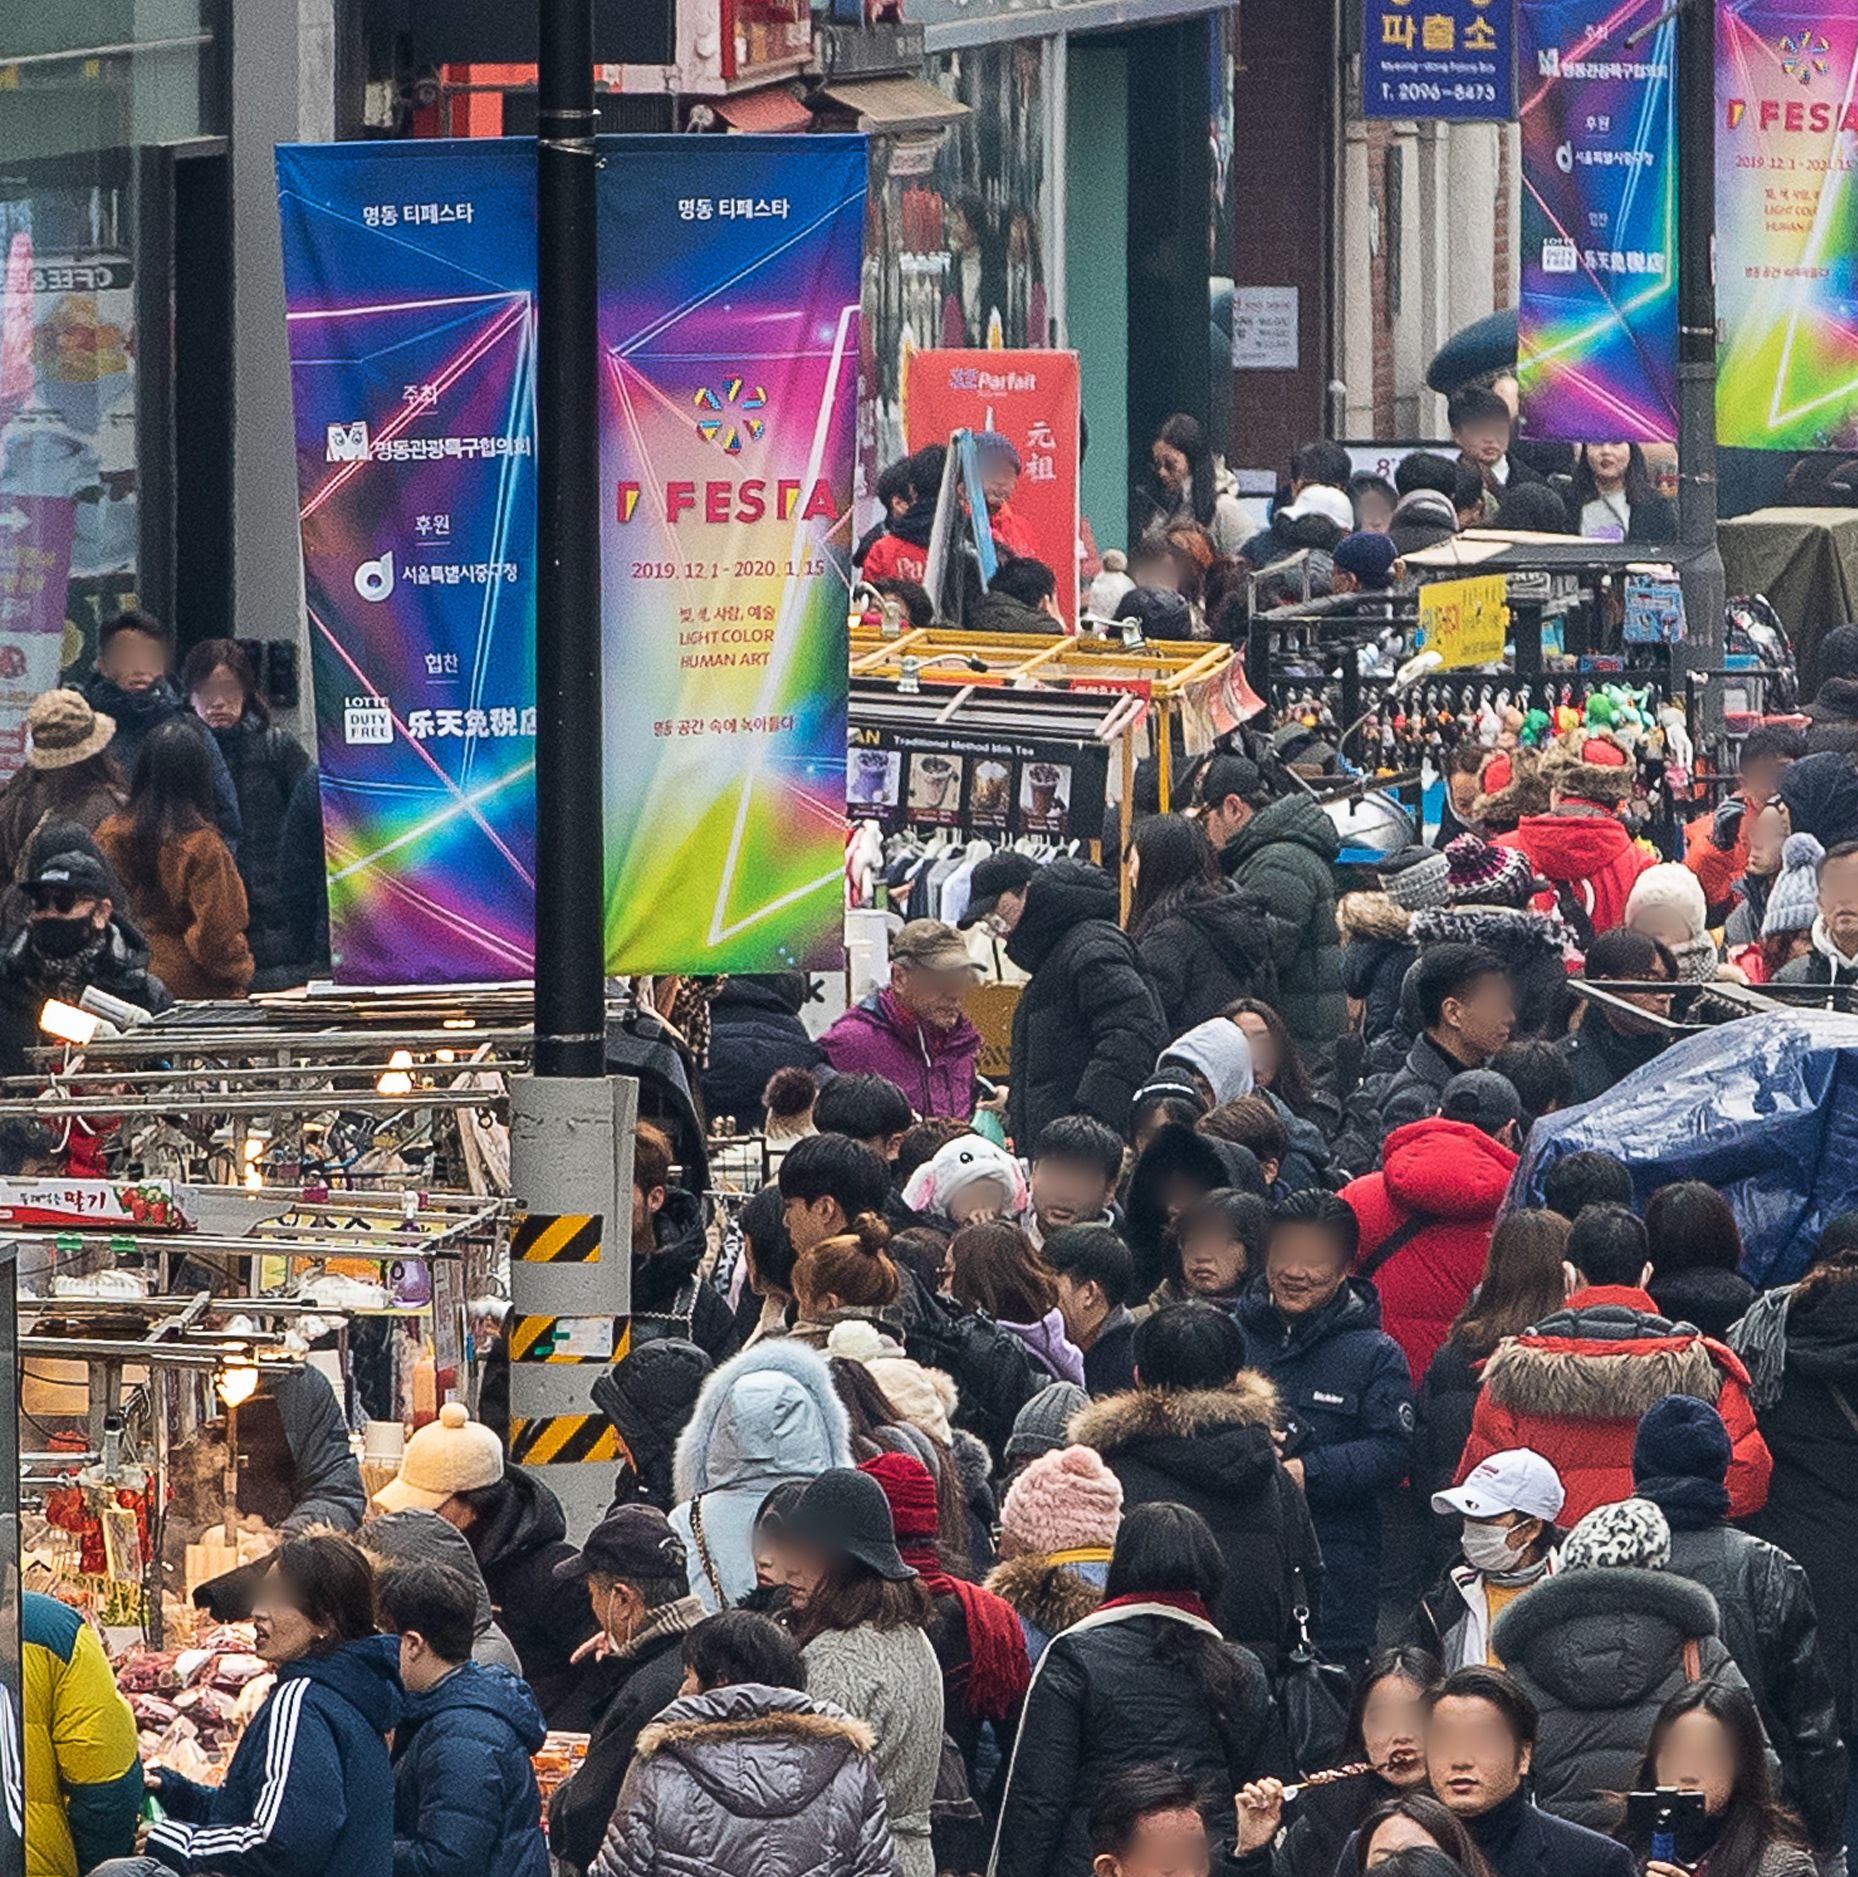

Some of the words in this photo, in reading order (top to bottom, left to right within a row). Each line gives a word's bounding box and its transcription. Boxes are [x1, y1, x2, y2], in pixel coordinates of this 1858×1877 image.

[1381, 13, 1498, 50] 파출소
[363, 204, 398, 226] 명동
[403, 202, 475, 225] 티페스타
[677, 198, 713, 221] 명동
[718, 198, 790, 220] 티페스타
[415, 514, 451, 535] 후원
[679, 630, 718, 646] LIGHT
[721, 629, 775, 643] COLOR
[424, 653, 459, 675] 협찬
[680, 653, 736, 668] HUMAN
[739, 652, 770, 667] ART
[344, 696, 390, 708] LOTTE
[350, 713, 387, 725] DUTY
[350, 727, 389, 739] FREE
[893, 735, 949, 750] Traditional
[951, 739, 990, 752] Method
[1015, 745, 1035, 757] Tea
